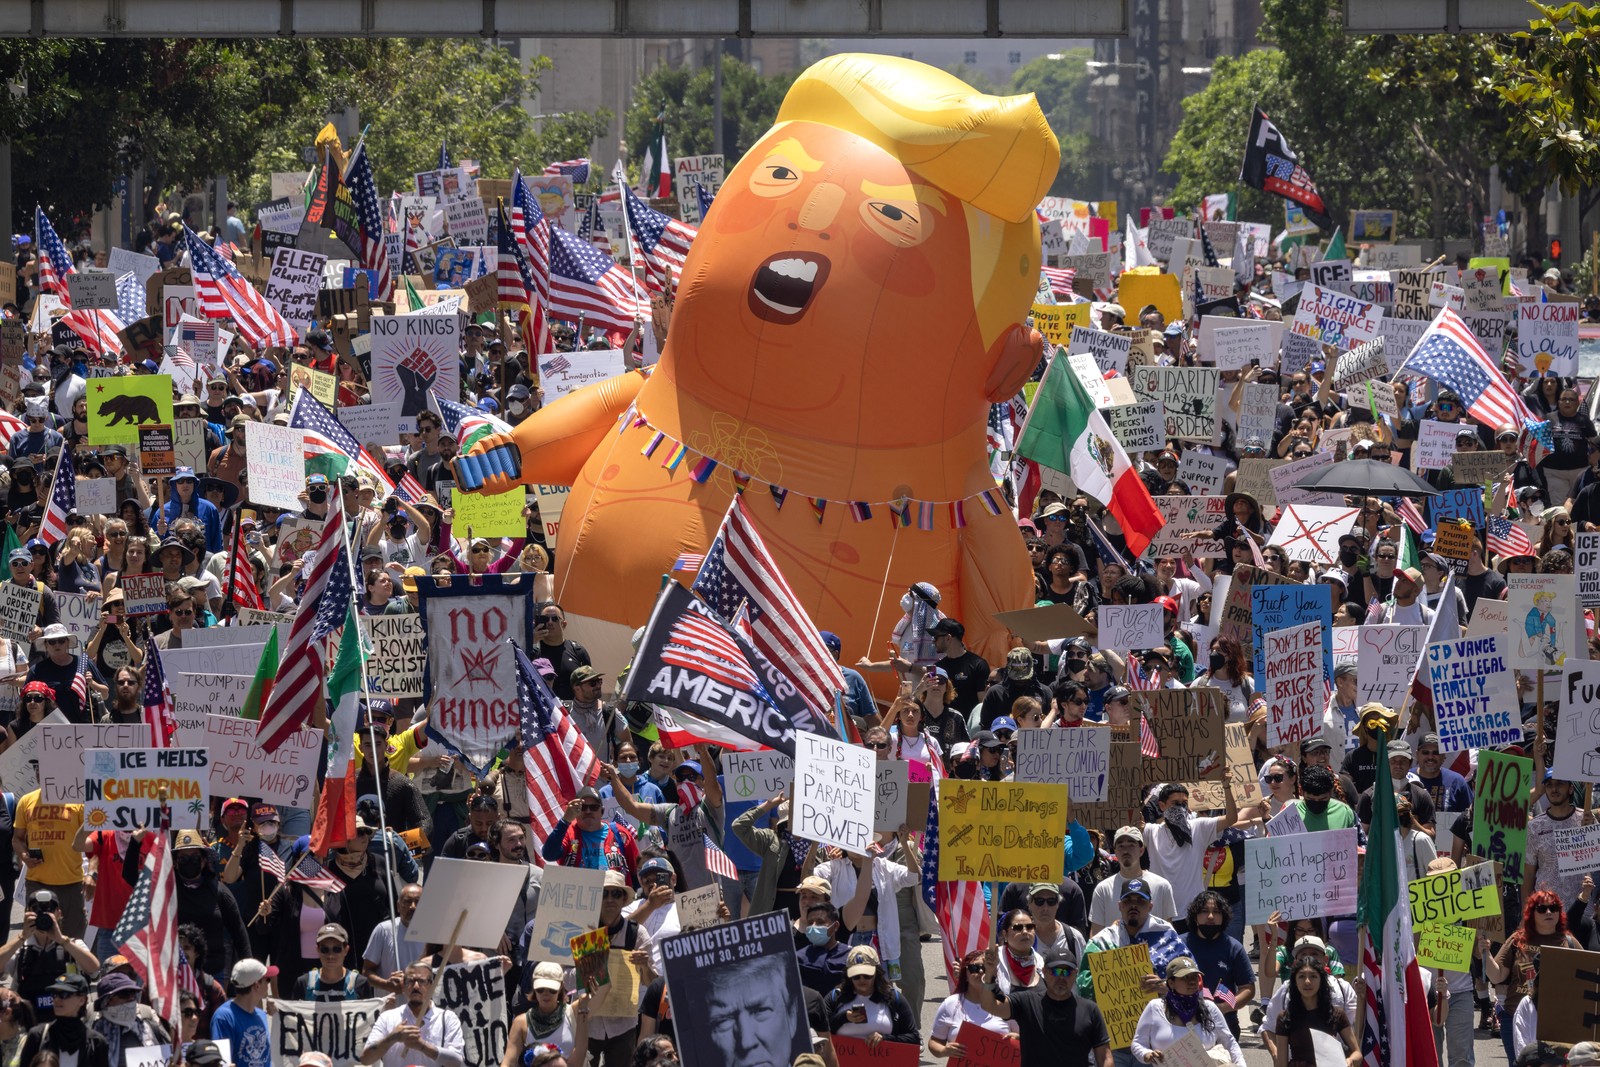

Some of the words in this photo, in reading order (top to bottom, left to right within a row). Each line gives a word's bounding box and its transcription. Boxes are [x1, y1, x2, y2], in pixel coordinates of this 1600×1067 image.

[678, 160, 702, 173] ALL
[683, 173, 697, 182] TO
[448, 212, 462, 221] WAS
[463, 209, 484, 219] ABOUT
[461, 201, 478, 210] THIS
[450, 219, 485, 230] CRIMINALS
[472, 228, 484, 237] PUT
[69, 275, 82, 283] ICE
[91, 274, 110, 283] TACKY
[1466, 281, 1477, 290] WE
[1480, 278, 1494, 289] ARE
[75, 297, 93, 306] HATE
[98, 297, 111, 305] YOU
[1350, 282, 1394, 303] SASHAY
[1398, 287, 1422, 306] THE
[1469, 294, 1496, 305] NATION
[1318, 291, 1367, 317] FIGHT
[1521, 306, 1540, 320] NO
[1542, 305, 1578, 322] CROWN
[1066, 312, 1077, 321] TO
[1300, 298, 1376, 333] IGNORANCE
[1319, 317, 1345, 333] NOT
[373, 319, 400, 336] NO
[407, 318, 455, 336] KINGS
[1038, 321, 1059, 330] LIVE
[1292, 320, 1368, 351] IMMIGRANT
[1227, 345, 1261, 355] BETTER
[1519, 338, 1577, 359] CLOWN
[560, 369, 608, 382] Immigration
[1125, 404, 1156, 417] EATING
[1123, 426, 1154, 438] EATING
[1420, 450, 1433, 458] and
[1198, 458, 1215, 470] YOU
[1180, 471, 1220, 487] SUPPORT
[1431, 492, 1453, 510] ICE
[1454, 487, 1483, 508] OUT
[459, 510, 475, 520] GET
[477, 509, 498, 520] OUT
[501, 508, 514, 517] OF
[1288, 519, 1337, 543] ICE
[1442, 530, 1469, 541] Trump
[1435, 546, 1469, 557] Regime
[1437, 538, 1471, 549] Fascist
[1577, 535, 1599, 549] ICE
[1456, 559, 1468, 567] GO
[1580, 571, 1599, 583] END
[2, 585, 9, 595] A
[11, 586, 40, 604] LAWFUL
[126, 588, 166, 601] NEIGHBOR
[1253, 586, 1290, 614] Fuck
[1295, 590, 1323, 621] You
[6, 596, 33, 613] ORDER
[19, 611, 37, 626] NOT
[371, 616, 424, 638] KINGS
[1105, 606, 1163, 635] FUCK
[1264, 613, 1284, 624] AND
[1114, 629, 1144, 651] ICE
[1304, 625, 1322, 648] BE
[1456, 636, 1497, 655] VANCE
[366, 656, 427, 676] FASCIST
[1266, 650, 1318, 680] ANOTHER
[1430, 664, 1450, 683] MY
[1451, 656, 1507, 679] ILLEGAL
[184, 674, 234, 691] TRUMP
[1275, 674, 1315, 701] BRICK
[1433, 676, 1487, 703] FAMILY
[176, 699, 213, 715] BROWN
[208, 691, 221, 704] OF
[1159, 689, 1183, 718] MI
[1183, 688, 1219, 717] PAPA
[1290, 694, 1316, 719] HIS
[1436, 696, 1492, 719] DIDN'T
[1468, 711, 1512, 730] CRACK
[42, 725, 85, 752] Fuck
[1022, 728, 1055, 751] THEY
[1058, 728, 1097, 750] FEAR
[1276, 718, 1322, 744] WALL
[1440, 737, 1459, 754] TO
[1459, 731, 1490, 751] YOUR
[1490, 727, 1521, 745] MOM
[119, 751, 148, 770] ICE
[156, 749, 209, 768] MELTS
[803, 737, 846, 763] THIS
[728, 753, 765, 775] HATE
[1018, 752, 1063, 776] PEOPLE
[1064, 749, 1108, 777] COMING
[211, 761, 245, 786] FOR
[834, 765, 872, 793] REAL
[1478, 760, 1521, 801] NO
[44, 776, 85, 803] Fuck
[84, 778, 102, 803] IN
[102, 776, 203, 801] CALIFORNIA
[803, 772, 864, 813] PARADE
[980, 787, 1006, 813] No
[1007, 788, 1060, 820] Kings
[801, 802, 871, 849] POWER
[977, 825, 1003, 847] No
[1003, 825, 1063, 850] Dictator
[1555, 837, 1571, 845] ARE
[1571, 834, 1587, 843] NOT
[1555, 839, 1595, 852] CRIMINALS
[1255, 840, 1298, 870] What
[1299, 846, 1350, 875] happens
[1556, 851, 1570, 859] THE
[955, 855, 976, 877] In
[978, 853, 1051, 882] America
[1280, 870, 1308, 886] one
[1408, 871, 1462, 904] STOP
[539, 880, 603, 912] MELT
[680, 890, 716, 909] Protest
[1258, 891, 1308, 914] happens
[663, 926, 741, 961] CONVICTED
[743, 913, 787, 941] FELON
[1443, 924, 1474, 942] SPEAK
[1436, 936, 1464, 953] those
[695, 954, 717, 969] MAY
[738, 941, 764, 960] 2024
[1090, 951, 1109, 973] WE
[1111, 947, 1132, 970] ARE
